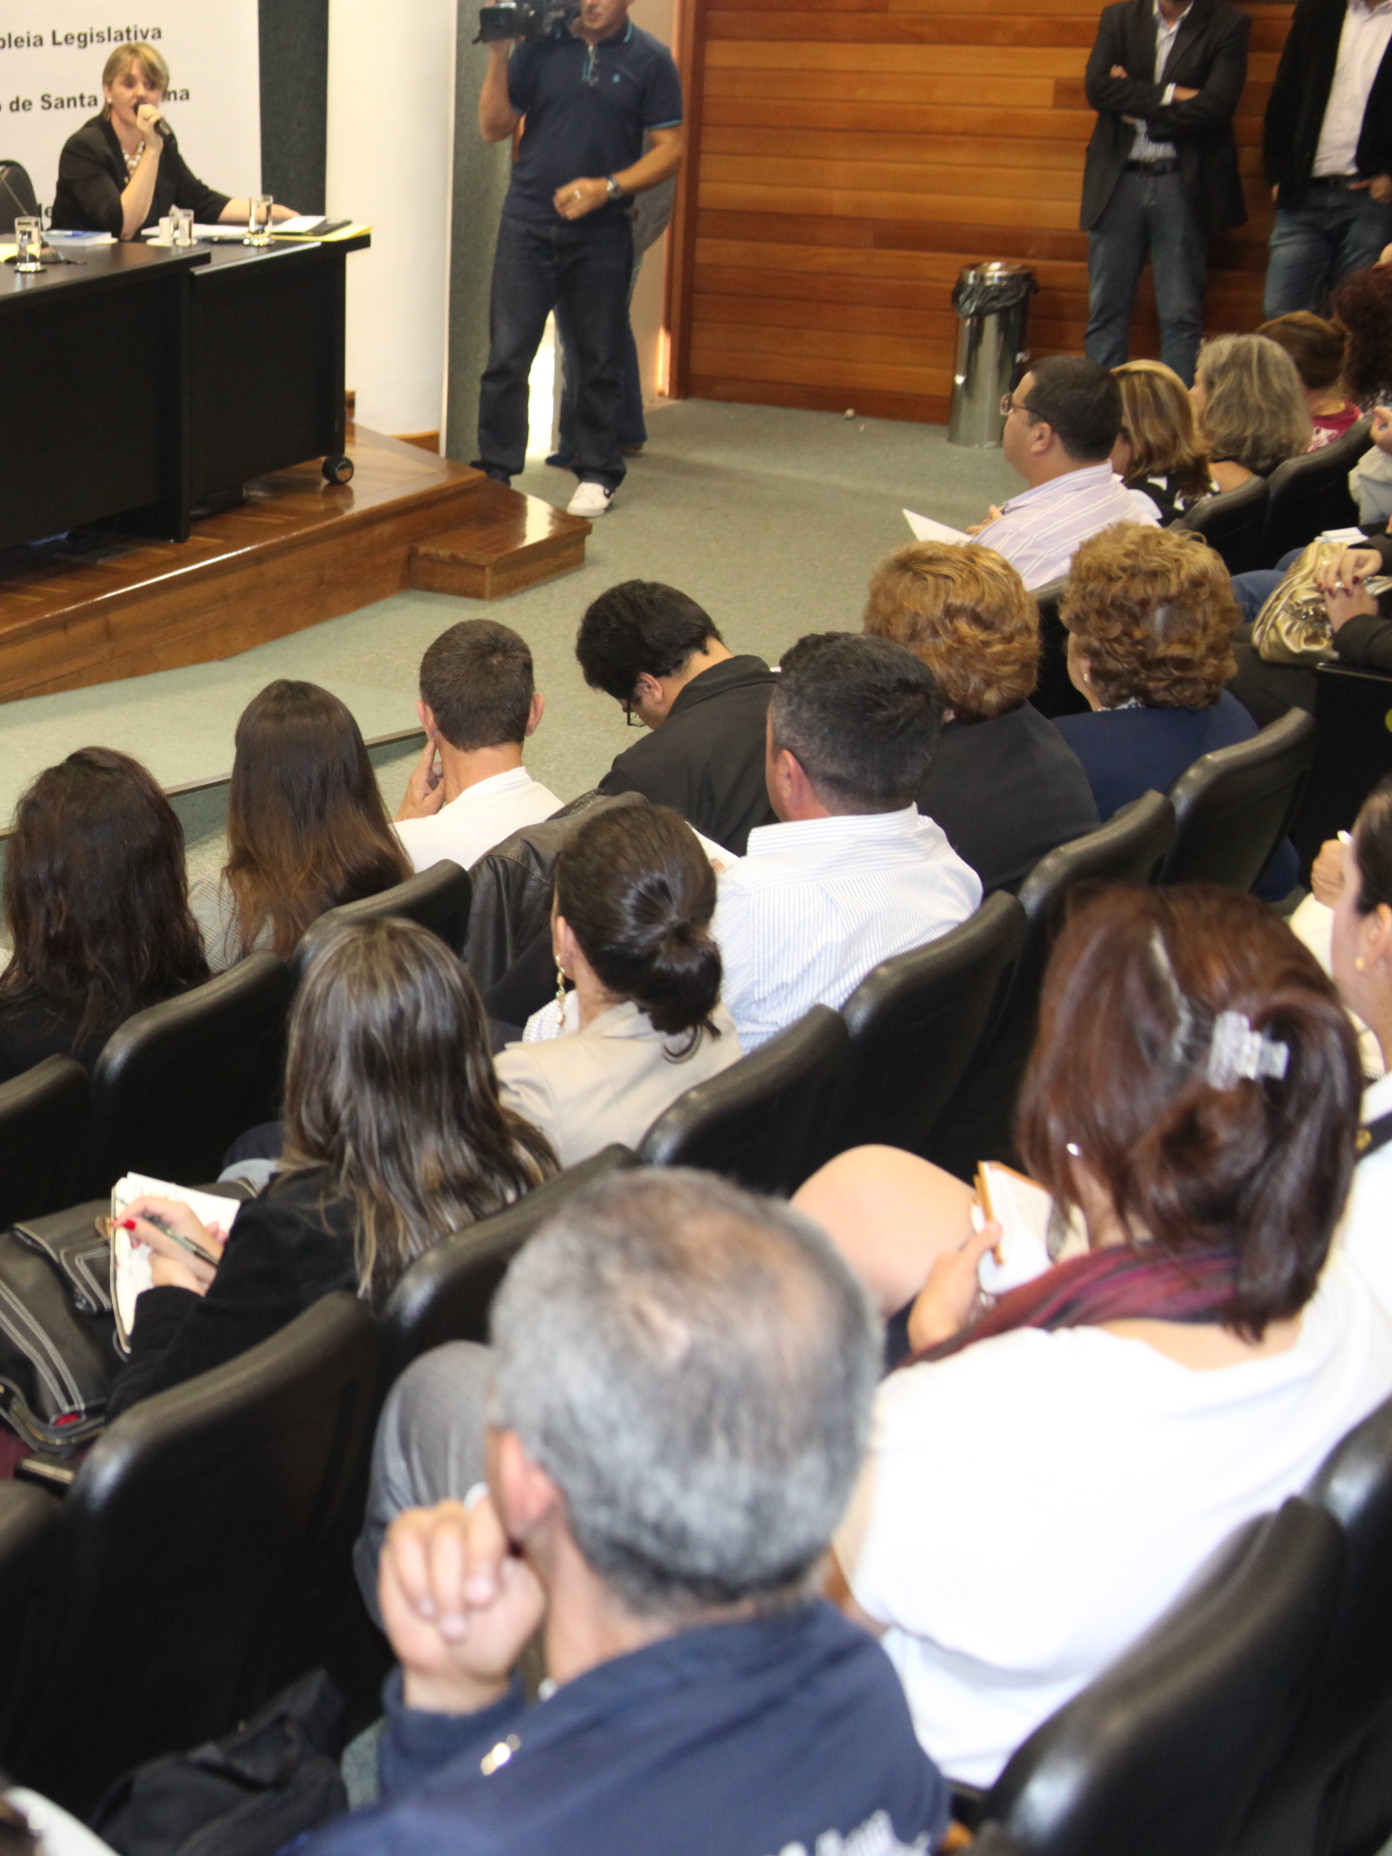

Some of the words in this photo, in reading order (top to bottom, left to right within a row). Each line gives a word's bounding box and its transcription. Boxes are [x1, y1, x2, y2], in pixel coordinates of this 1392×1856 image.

[52, 24, 163, 48] Legislativa
[9, 95, 34, 112] de
[40, 92, 98, 110] Santa
